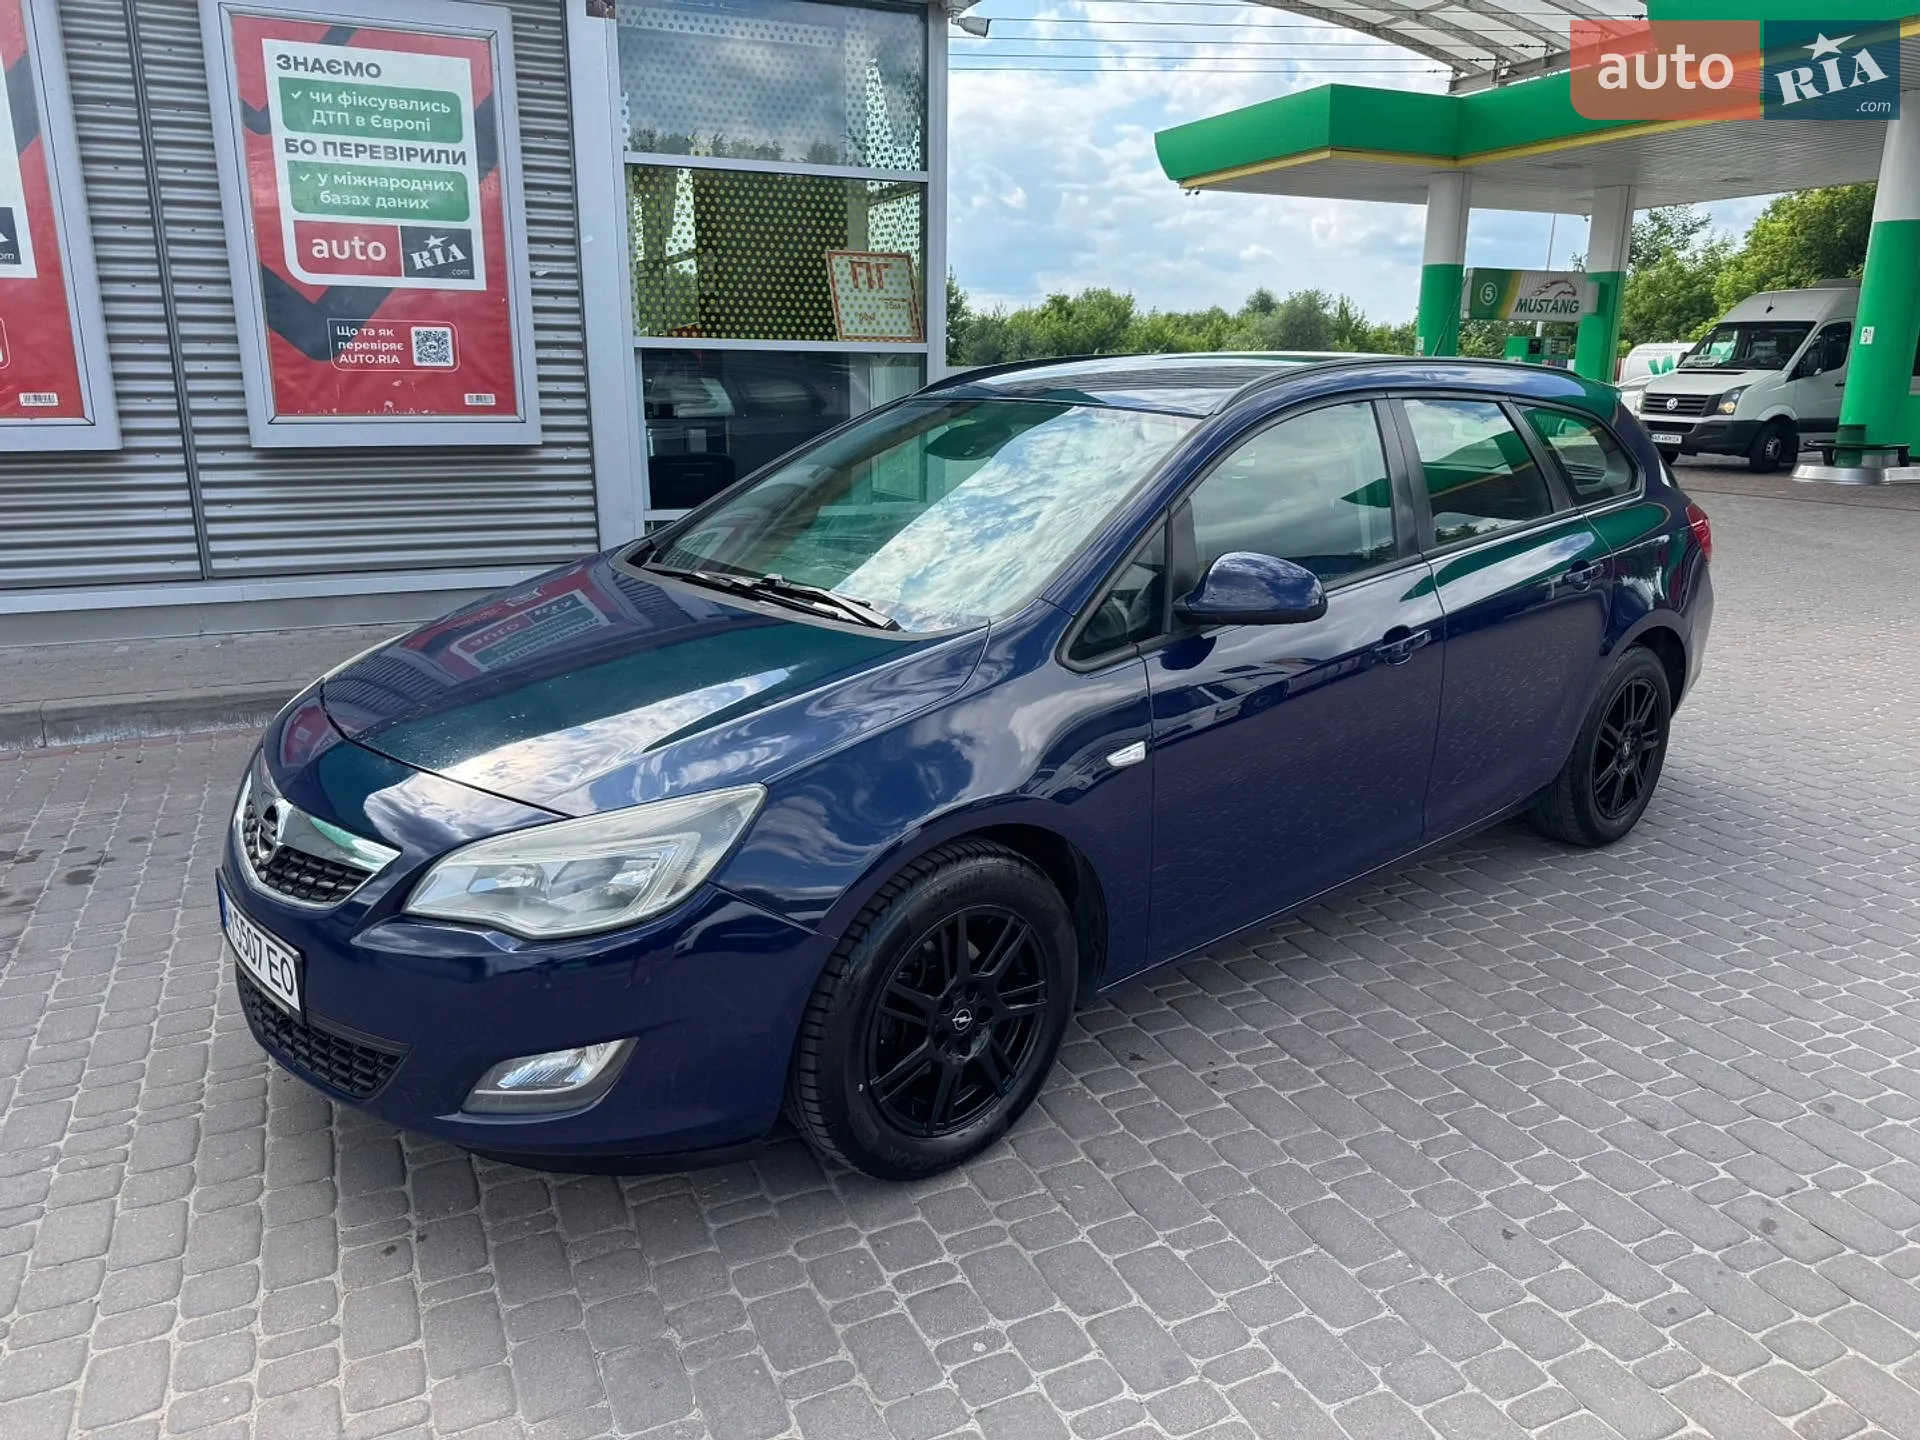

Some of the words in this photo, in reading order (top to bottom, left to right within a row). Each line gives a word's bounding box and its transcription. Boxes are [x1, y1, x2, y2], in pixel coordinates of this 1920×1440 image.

[276, 54, 382, 79] ЗНАЄМО
[309, 91, 332, 104] чи
[338, 90, 451, 113] фіксувались
[312, 109, 350, 126] ДТП
[355, 115, 366, 127] в
[370, 115, 431, 132] Європі
[284, 138, 318, 155] БО
[323, 140, 467, 166] ПЕРЕВІРИЛИ
[317, 173, 329, 187] у
[333, 171, 455, 192] міжнародних
[319, 190, 371, 206] базах
[375, 196, 430, 210] даних
[311, 235, 387, 262] auto
[410, 243, 467, 271] RIA
[1484, 287, 1494, 300] 5
[1514, 298, 1580, 314] MUSTANG
[336, 326, 359, 337] Що
[361, 327, 375, 336] та
[378, 327, 394, 337] як
[337, 340, 404, 351] перевіряє
[339, 354, 401, 364] AUTO.RIA
[266, 944, 295, 996] EO
